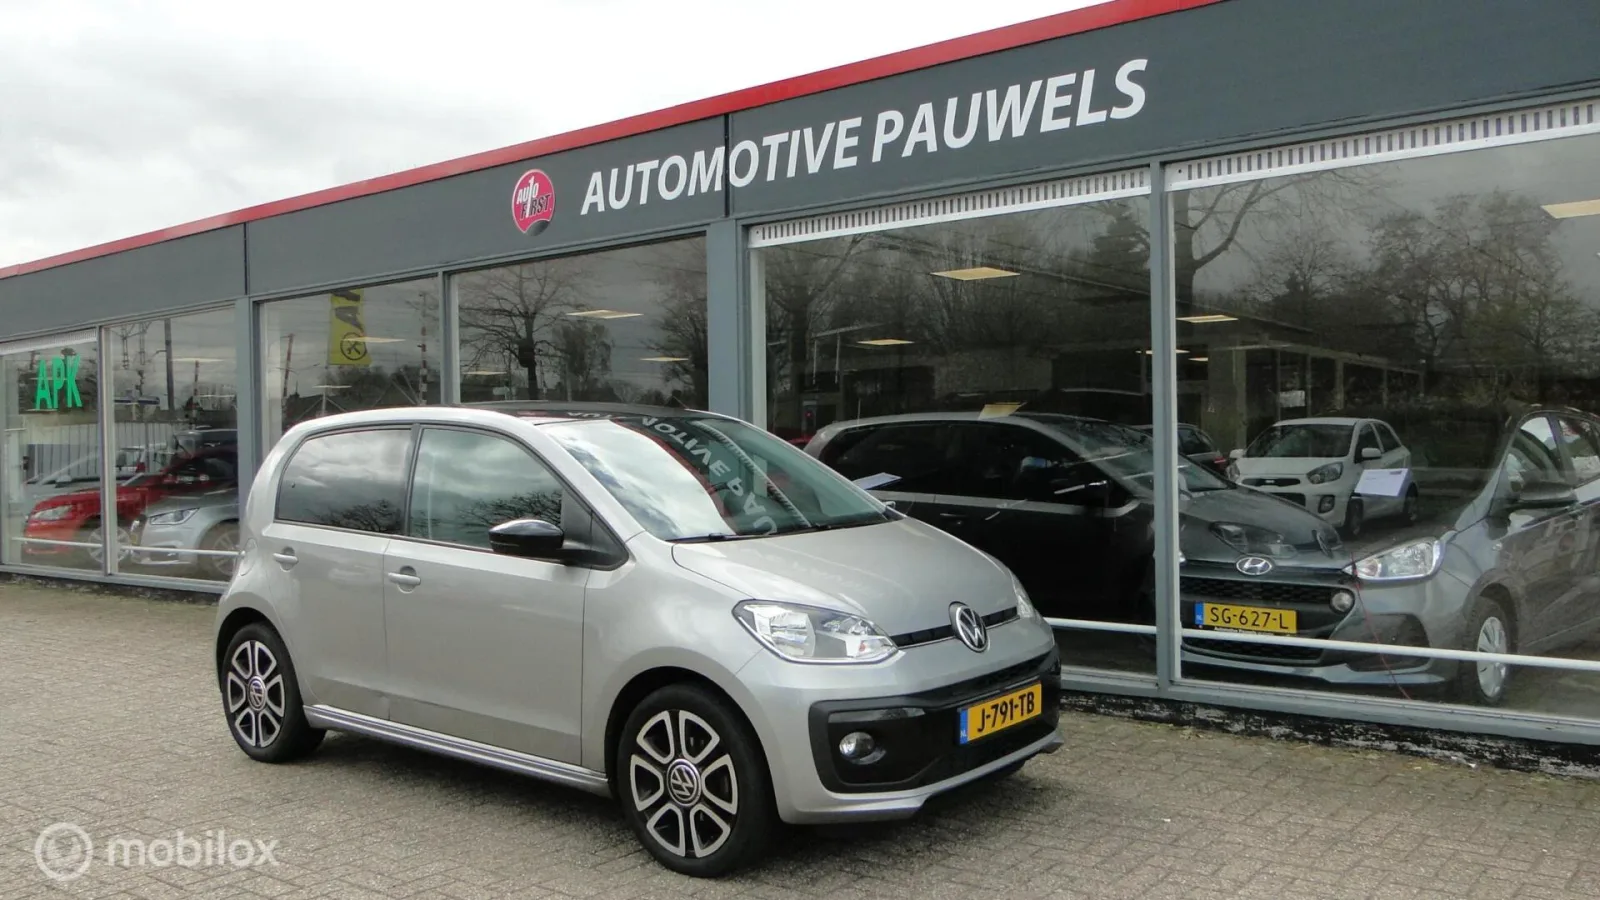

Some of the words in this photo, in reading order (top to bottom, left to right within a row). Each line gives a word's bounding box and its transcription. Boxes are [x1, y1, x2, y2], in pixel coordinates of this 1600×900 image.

[580, 116, 862, 215] AUTOMOTIVE
[872, 58, 1148, 162] PAUWELS
[35, 354, 82, 410] APK
[1210, 606, 1289, 630] SG-627-L
[977, 691, 1035, 733] J-791-TB
